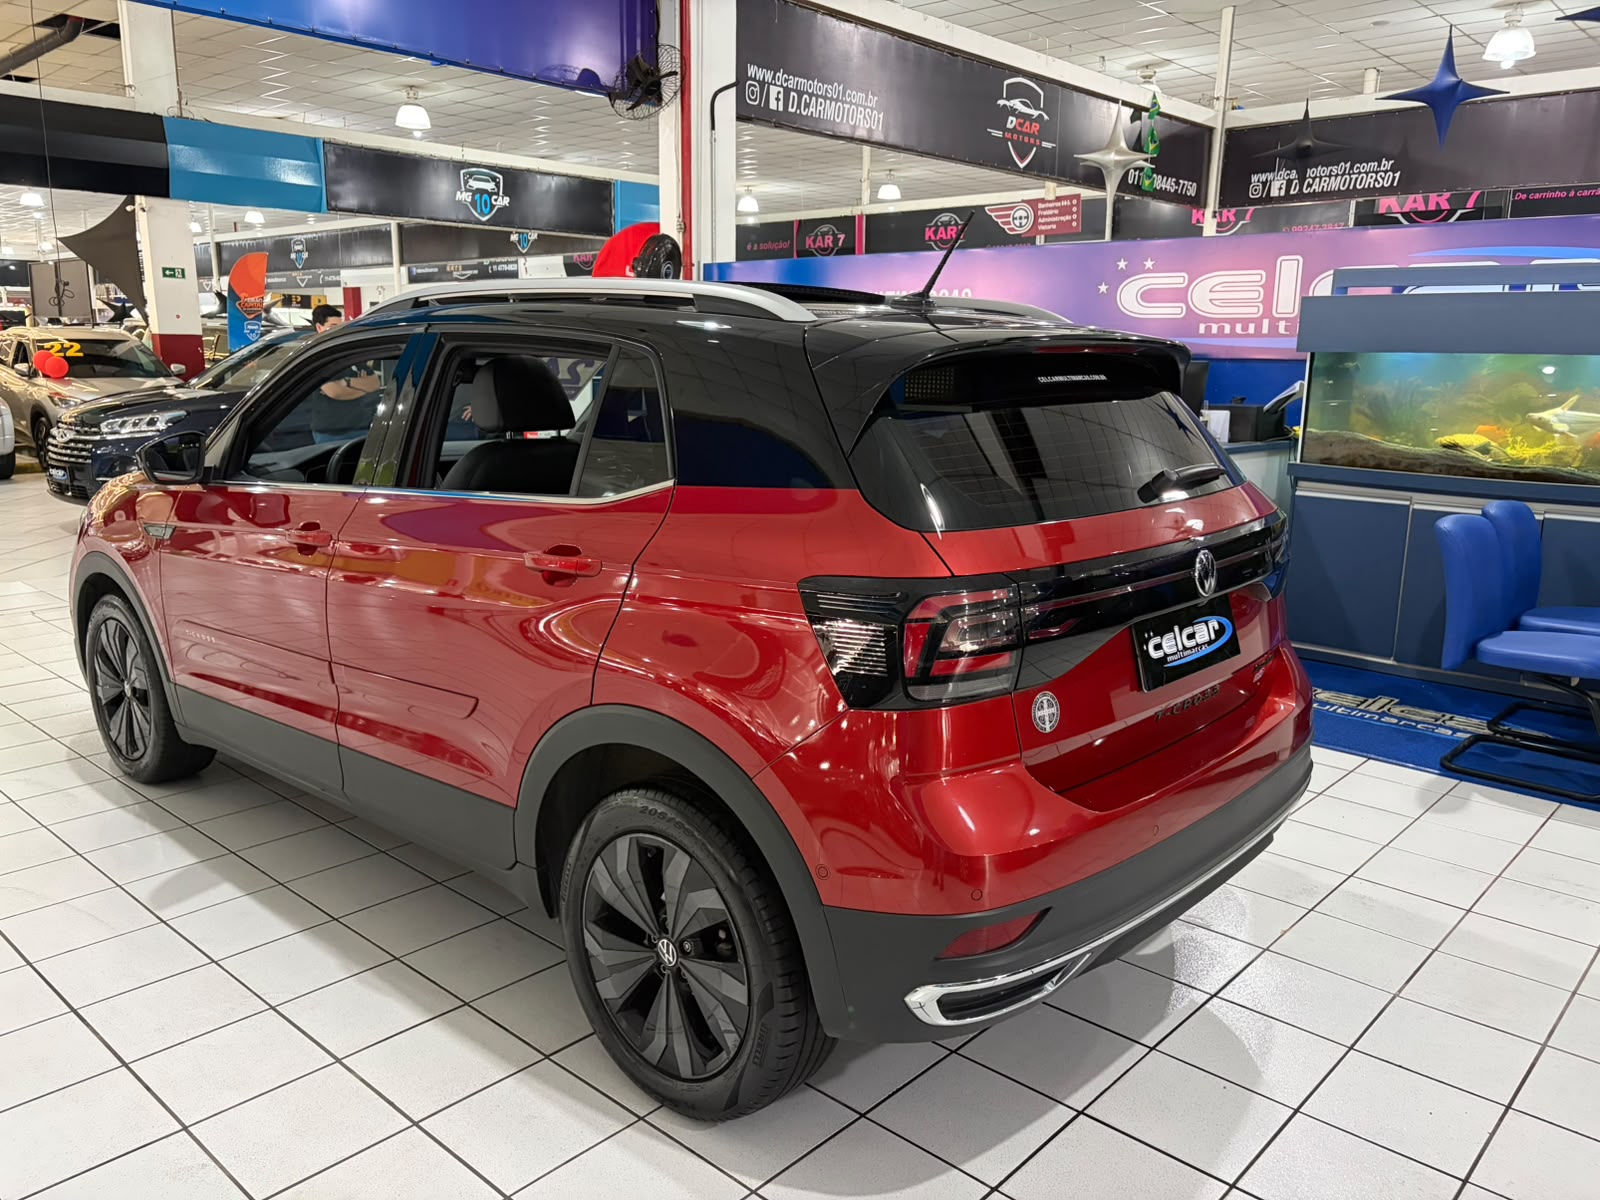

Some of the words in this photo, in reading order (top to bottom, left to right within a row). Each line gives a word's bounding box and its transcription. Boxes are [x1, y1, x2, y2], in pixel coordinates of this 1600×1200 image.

[747, 63, 878, 108] www.dcarmotors01.com.br
[788, 91, 884, 131] D.CARMOTORS01
[1006, 116, 1040, 135] DCAR
[1004, 132, 1041, 146] MOTORS
[1251, 157, 1395, 183] www.dcaotors01.com.br
[1290, 171, 1401, 195] DCARMOTORS01
[456, 191, 472, 202] MG
[474, 193, 491, 214] 10
[491, 195, 510, 207] CAR
[1514, 192, 1527, 200] De
[1528, 190, 1567, 200] carrinho
[1038, 201, 1061, 209] Banheiros
[1038, 214, 1072, 223] Administração
[1192, 208, 1237, 225] KR
[760, 240, 791, 252] solução!
[805, 235, 834, 249] KAR
[837, 234, 846, 247] 7
[1199, 318, 1300, 336] mult
[1148, 619, 1219, 660] celcar
[1167, 643, 1210, 663] multimarcas
[1313, 702, 1486, 739] ultimarcas
